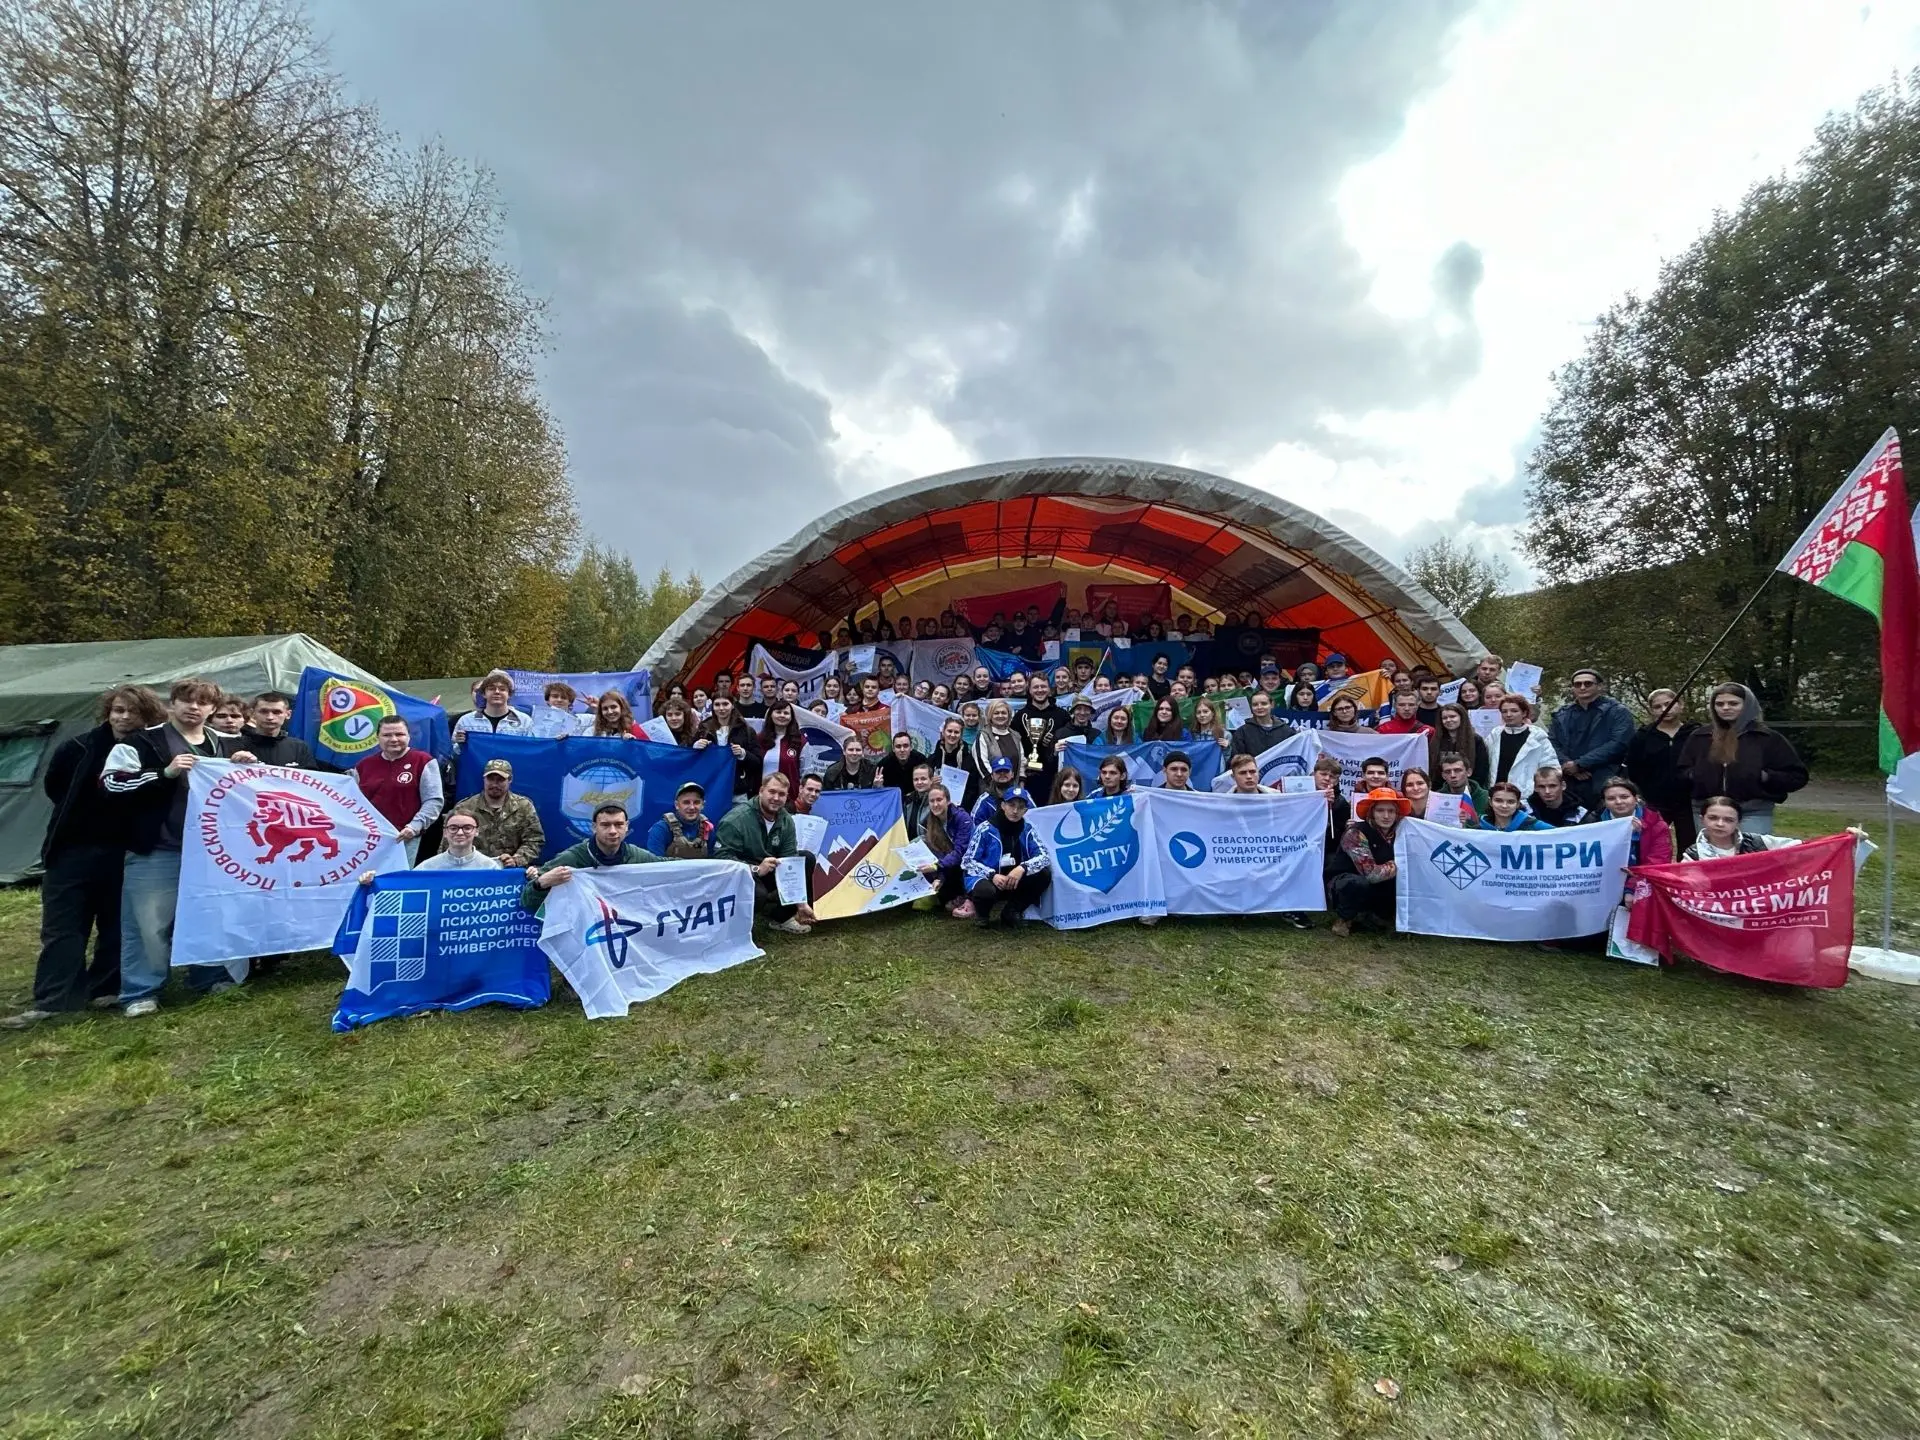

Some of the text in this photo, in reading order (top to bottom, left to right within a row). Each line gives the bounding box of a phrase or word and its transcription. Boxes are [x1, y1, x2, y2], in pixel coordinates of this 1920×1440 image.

[349, 718, 369, 736] У
[205, 767, 356, 809] ГОСУДАРСТВЕННЫЙ
[1211, 833, 1307, 844] СЕВАСТОПОЛЬСКИЙ
[199, 811, 276, 891] ПСКОВСКИЙ
[1212, 842, 1308, 854] ГОСУДАРСТВЕННЫЙ
[1500, 840, 1603, 870] МГРИ
[1068, 843, 1131, 877] БрГТУ
[1213, 855, 1282, 864] УНИВЕРСИТЕТ
[1495, 873, 1538, 881] РОССИЙСКИЙ
[1559, 879, 1602, 888] УНИВЕРСИТЕТ
[1666, 870, 1833, 900] ПРЕЗИДЕНТСКАЯ
[440, 911, 532, 928] ПСИХОЛОГО-
[656, 894, 736, 938] ГУАП
[439, 924, 542, 942] ПЕДАГОГИЧЕС
[439, 938, 537, 956] УНИВЕРСИТЕТ
